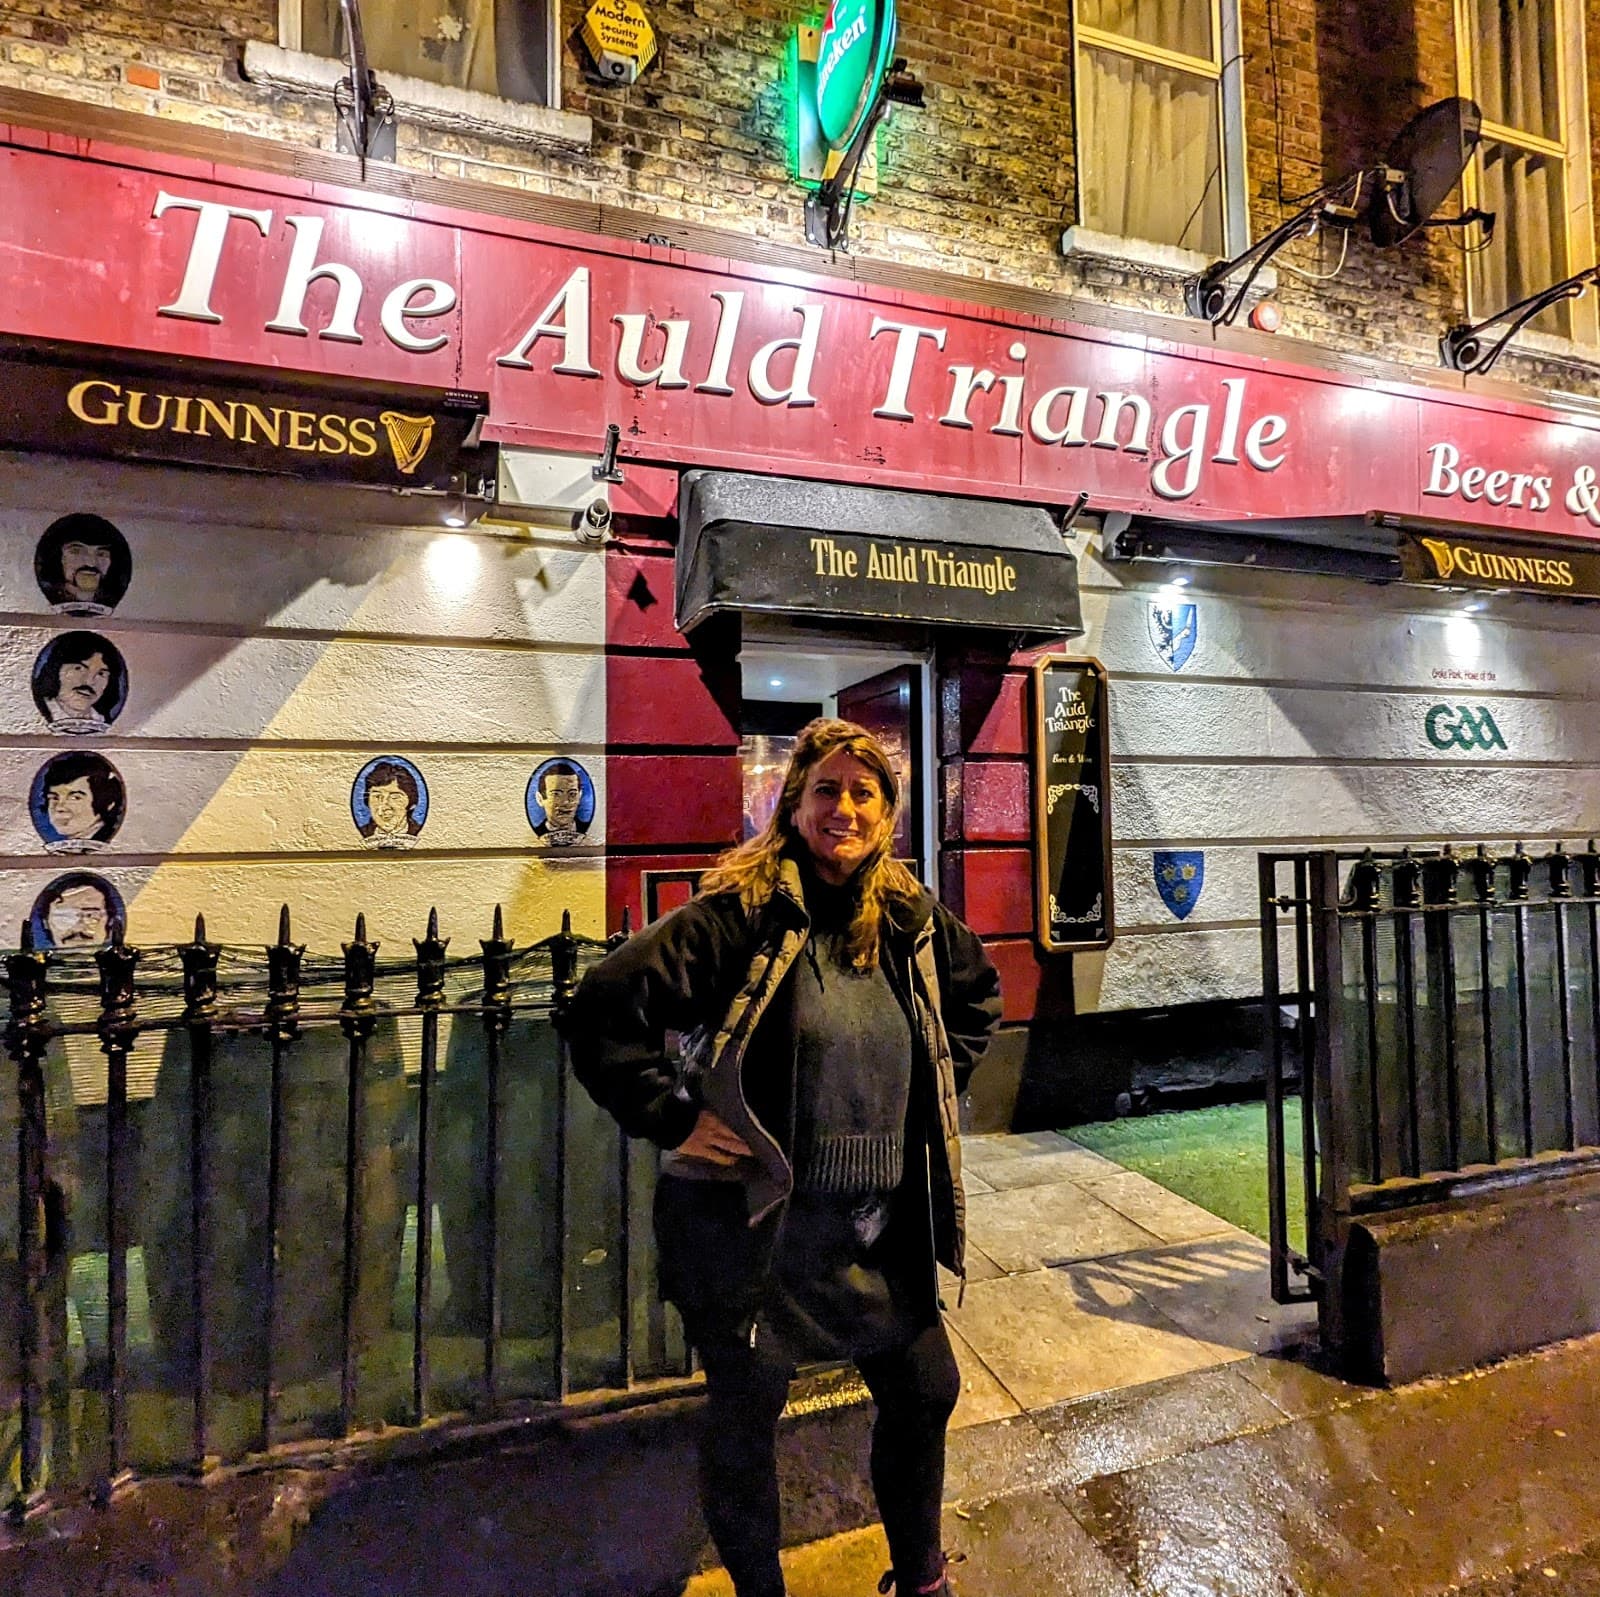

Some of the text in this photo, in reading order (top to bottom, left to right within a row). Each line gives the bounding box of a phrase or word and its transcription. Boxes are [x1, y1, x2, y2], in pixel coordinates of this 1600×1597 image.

[595, 5, 645, 28] Modern
[600, 22, 639, 40] Security
[601, 32, 639, 50] Systems
[151, 190, 1288, 500] The Auld Triangle
[67, 380, 379, 457] GUINNESS
[1423, 442, 1600, 527] Beers &
[810, 538, 1017, 596] The Auld Triangle
[1453, 546, 1574, 586] GUINNESS
[1054, 701, 1086, 718] Auld
[1058, 686, 1082, 702] The
[1045, 715, 1096, 734] Triangle
[1425, 703, 1508, 750] GAA
